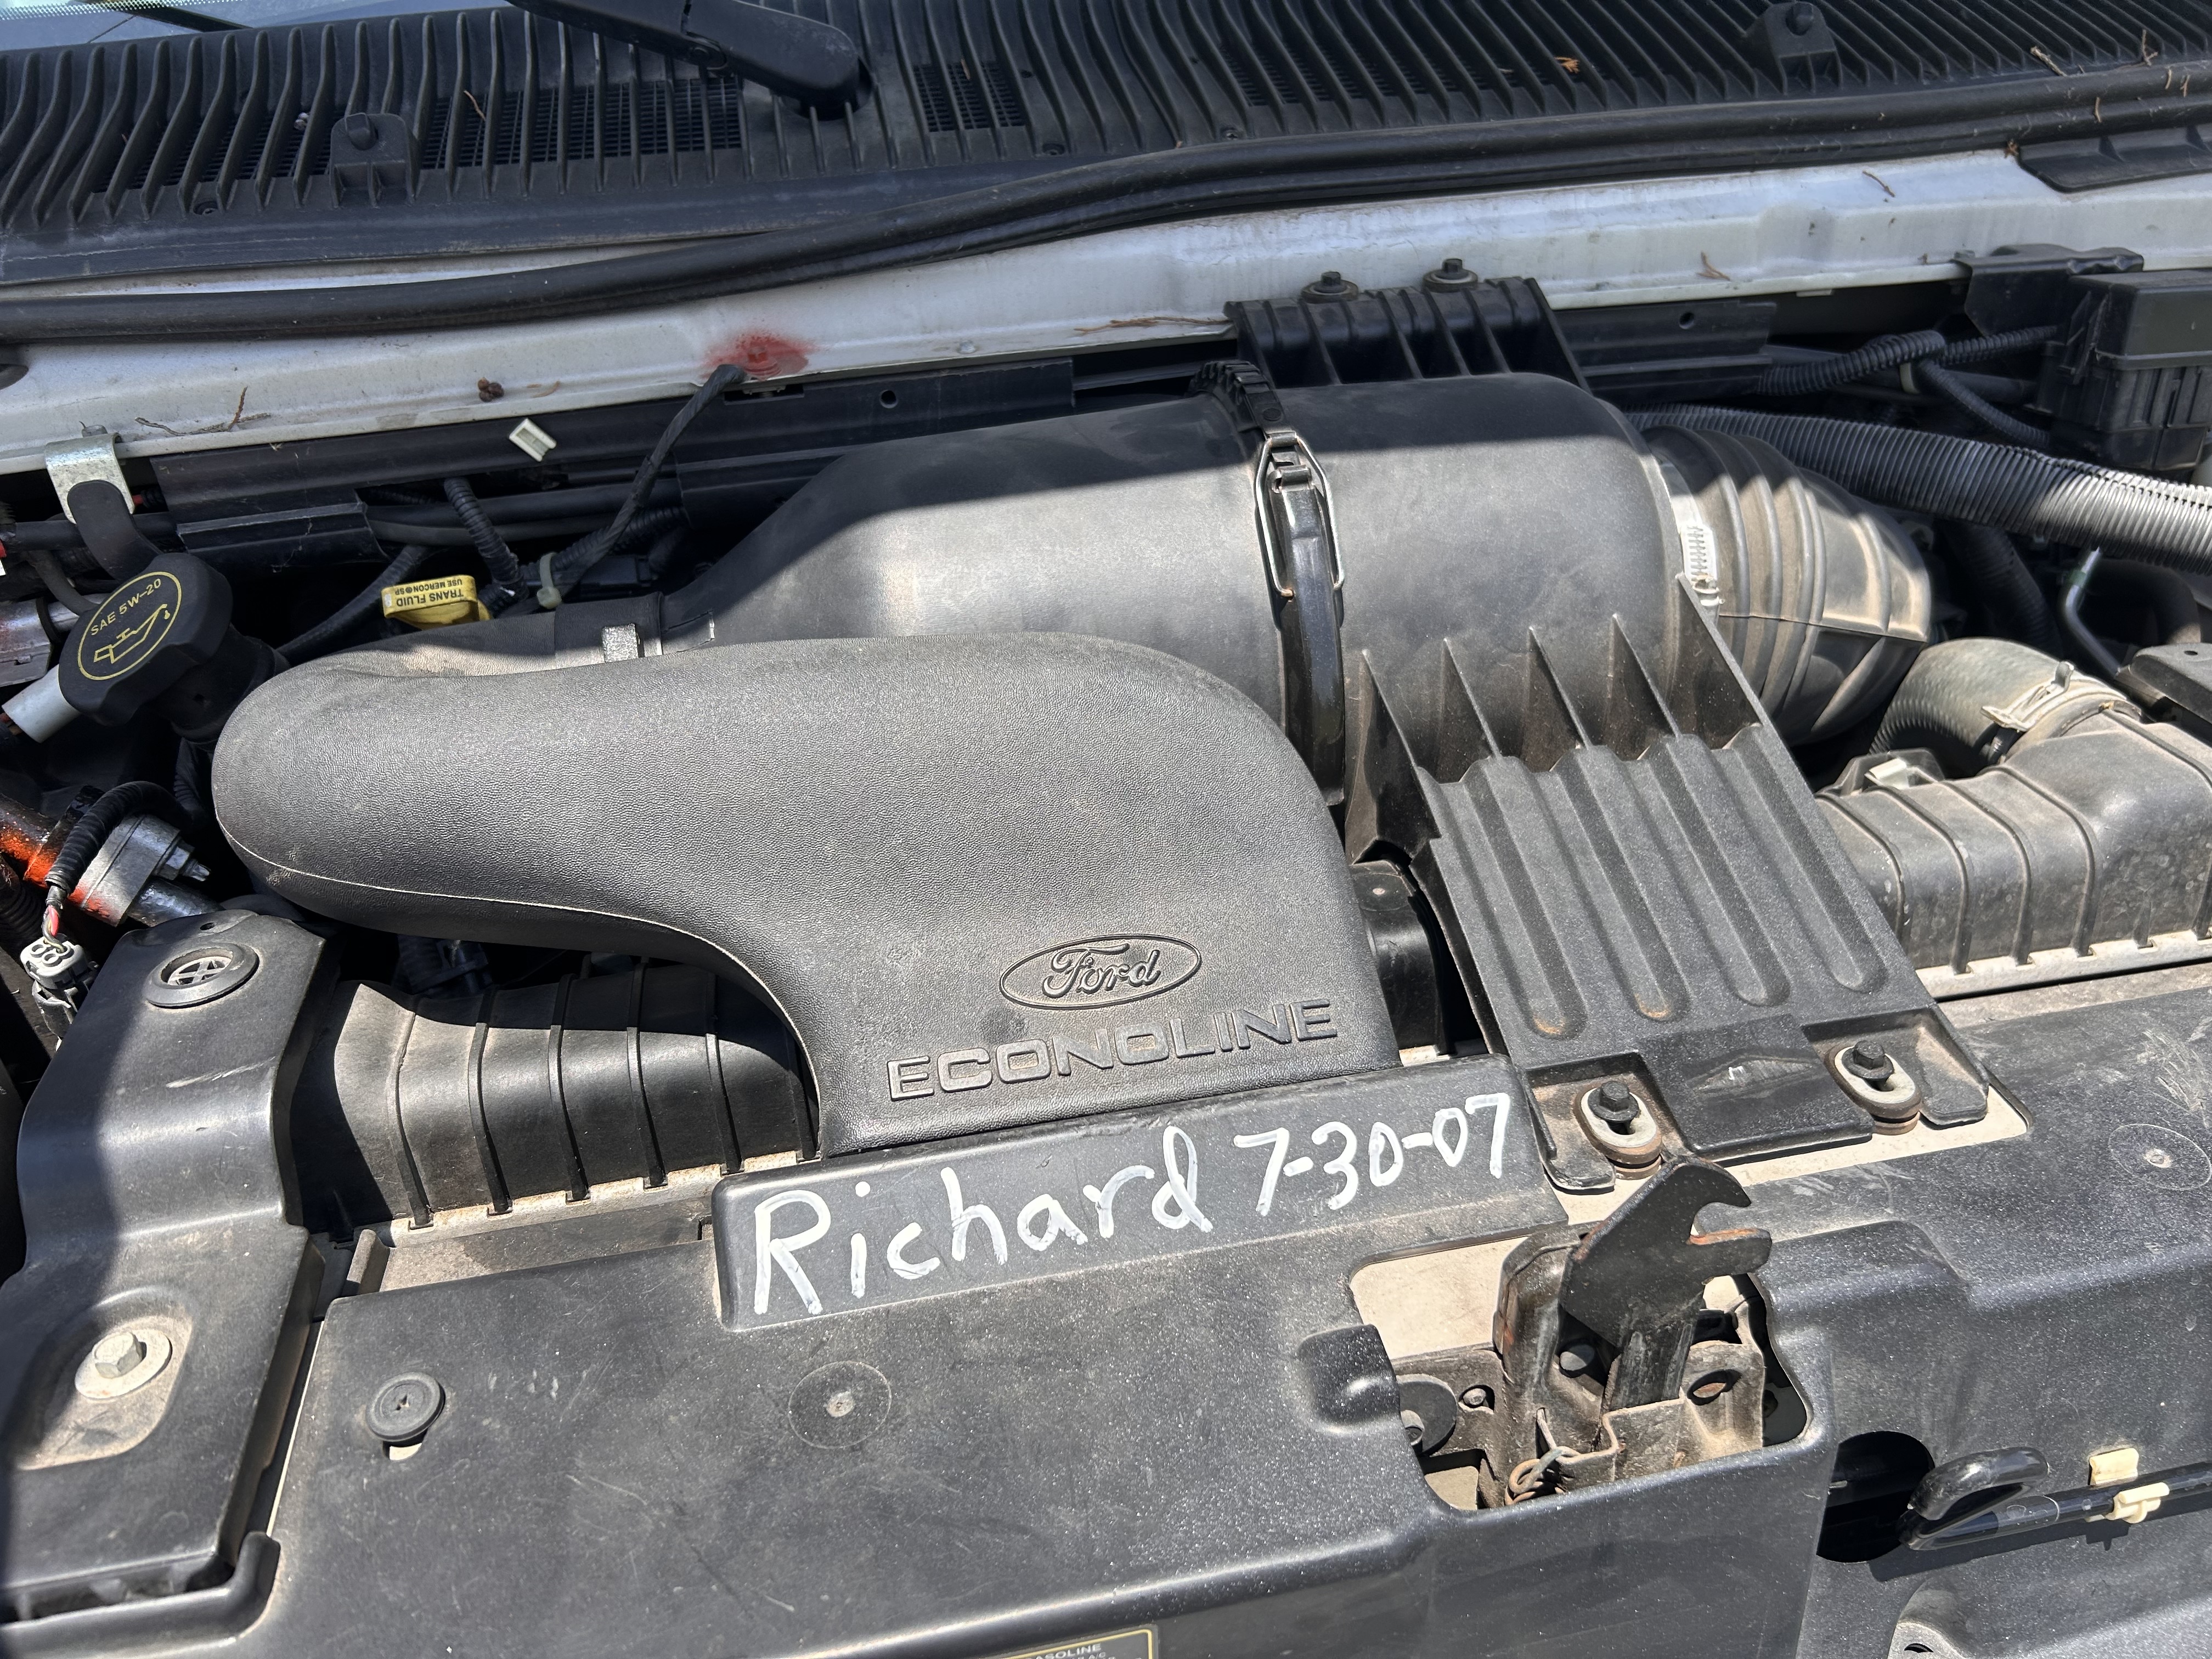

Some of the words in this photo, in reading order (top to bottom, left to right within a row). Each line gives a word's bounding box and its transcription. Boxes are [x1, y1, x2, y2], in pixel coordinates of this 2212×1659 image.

[396, 595, 426, 607] FLUID
[429, 589, 464, 602] TRANS
[447, 579, 462, 588] USE
[91, 612, 116, 636] SAE
[119, 578, 161, 614] 5W-20
[1042, 943, 1161, 999] Ford
[886, 999, 1339, 1102] ECONOLINE
[753, 1125, 1214, 1315] Richard
[1233, 1092, 1511, 1217] 7-30-07
[1025, 1643, 1102, 1659] ASOLINE
